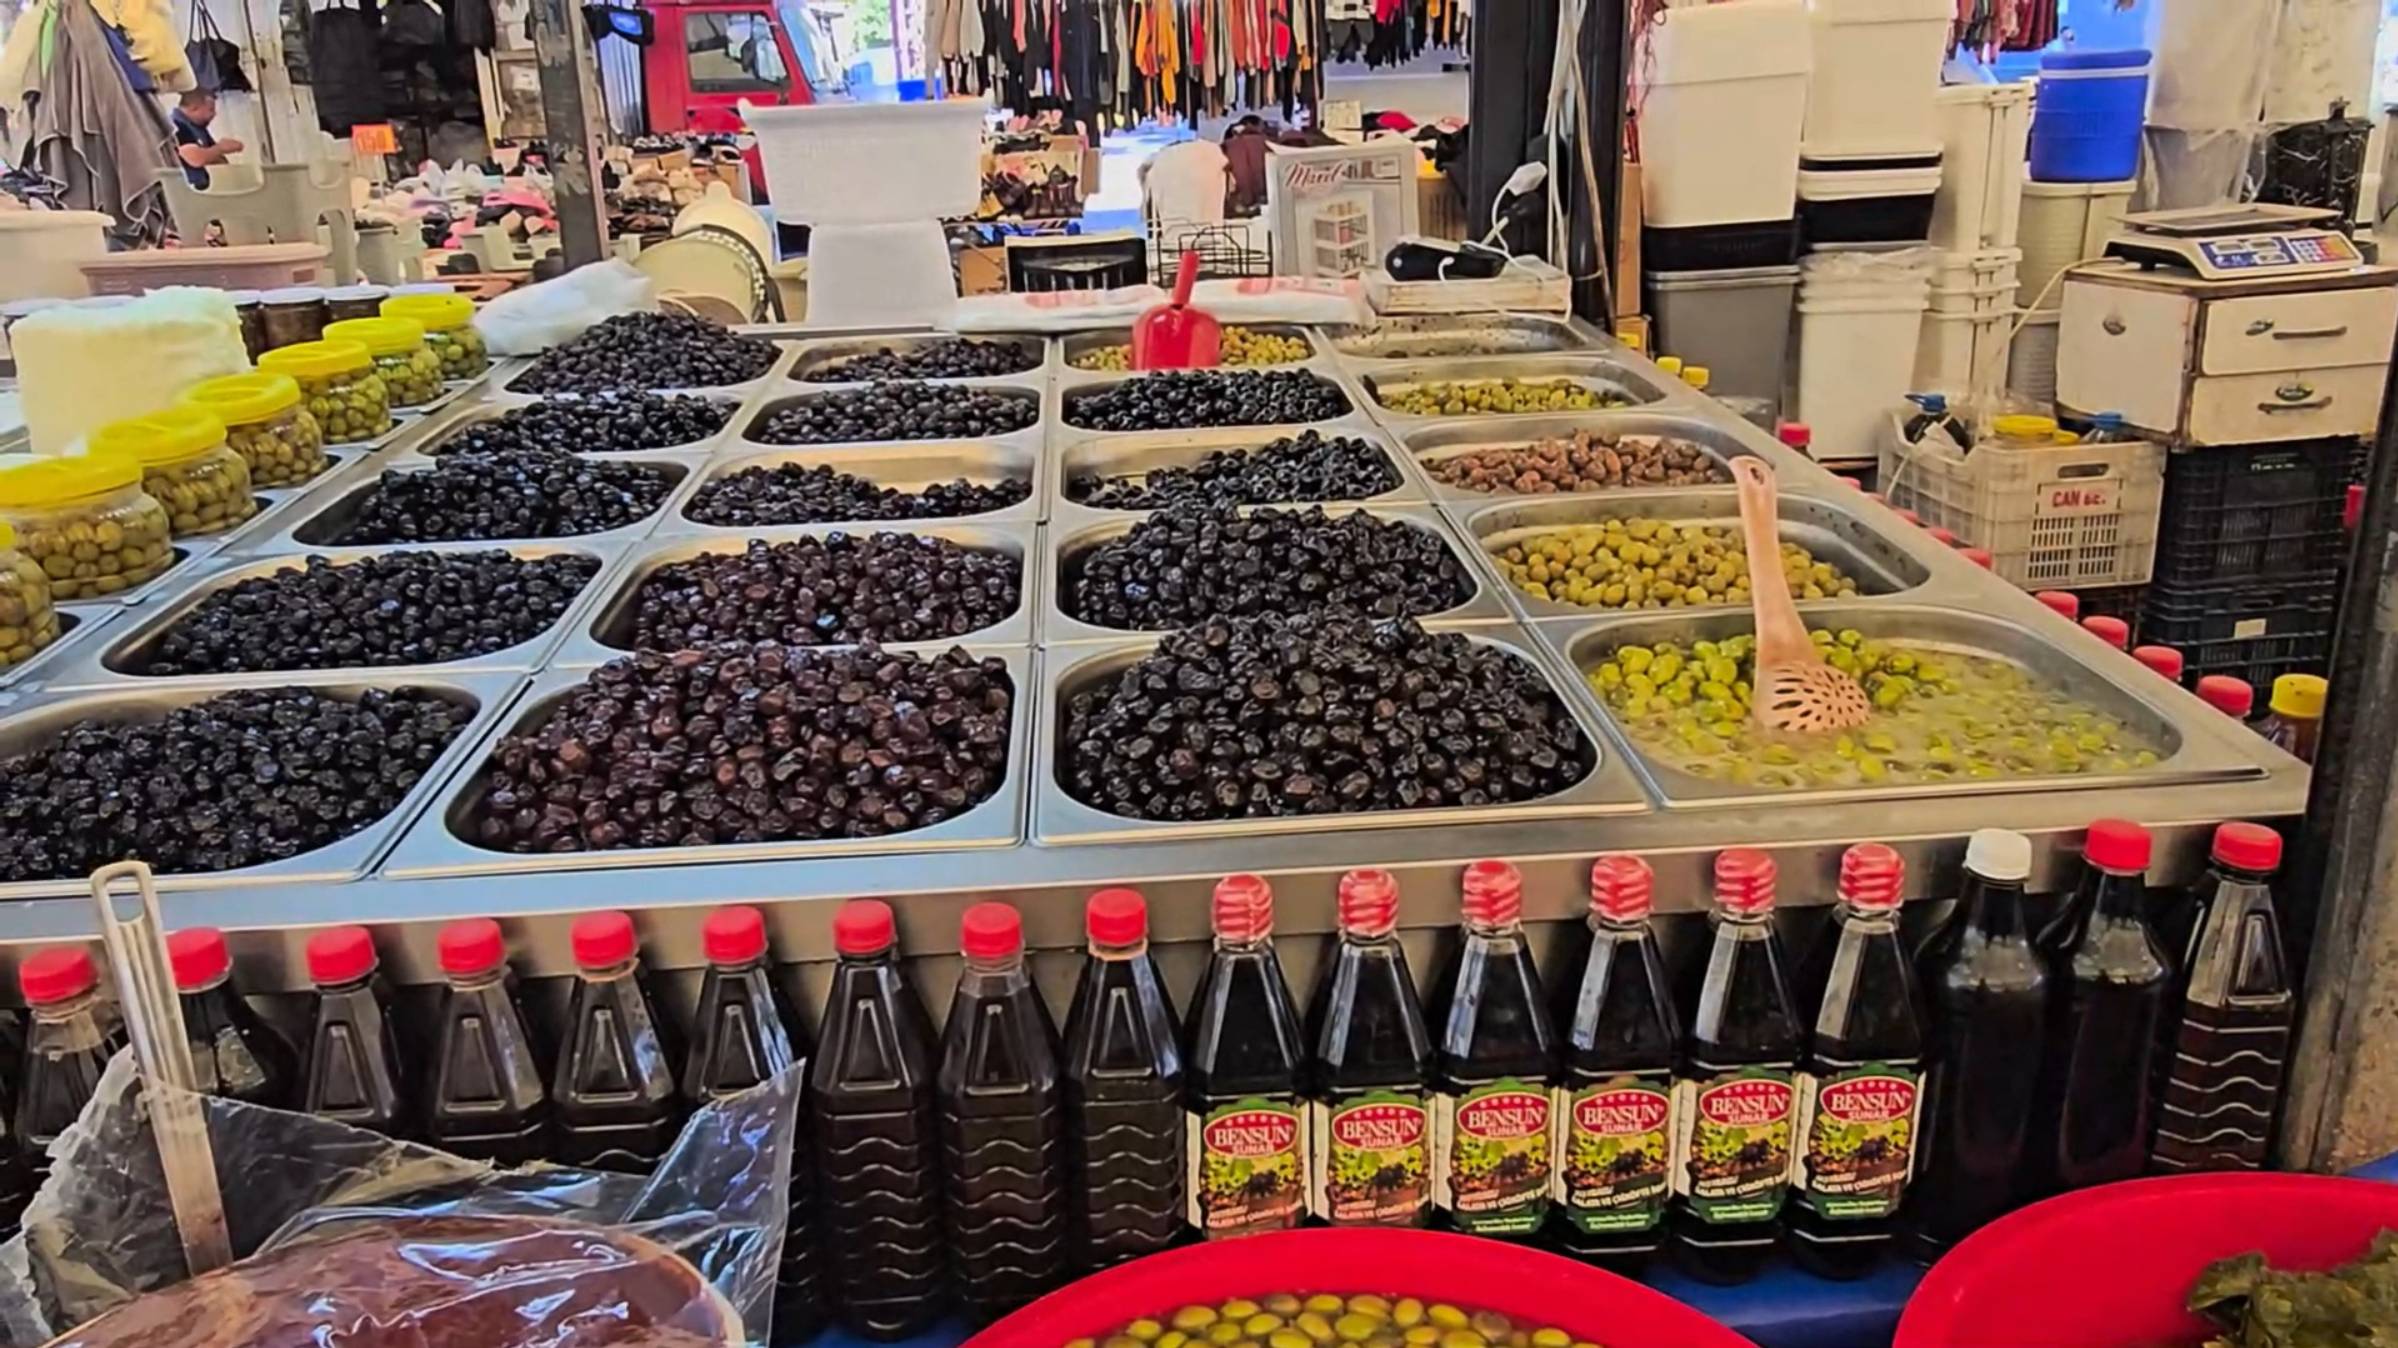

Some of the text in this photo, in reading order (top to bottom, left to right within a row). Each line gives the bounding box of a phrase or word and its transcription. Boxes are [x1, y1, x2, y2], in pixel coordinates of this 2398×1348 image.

[2052, 491, 2081, 508] CAN
[1711, 1095, 1786, 1115] BENSUN
[1832, 1092, 1905, 1113] BENSUN
[1468, 1107, 1543, 1128] BENSUN
[1584, 1105, 1658, 1125] BENSUN
[1728, 1113, 1769, 1125] SUNAR
[1848, 1110, 1890, 1121] SUNAR
[1215, 1126, 1291, 1147] BENSUN
[1342, 1119, 1418, 1139] BENSUN
[1486, 1124, 1527, 1136] SUNAR
[1601, 1122, 1642, 1134] SUNAR
[1360, 1136, 1402, 1148] SUNAR
